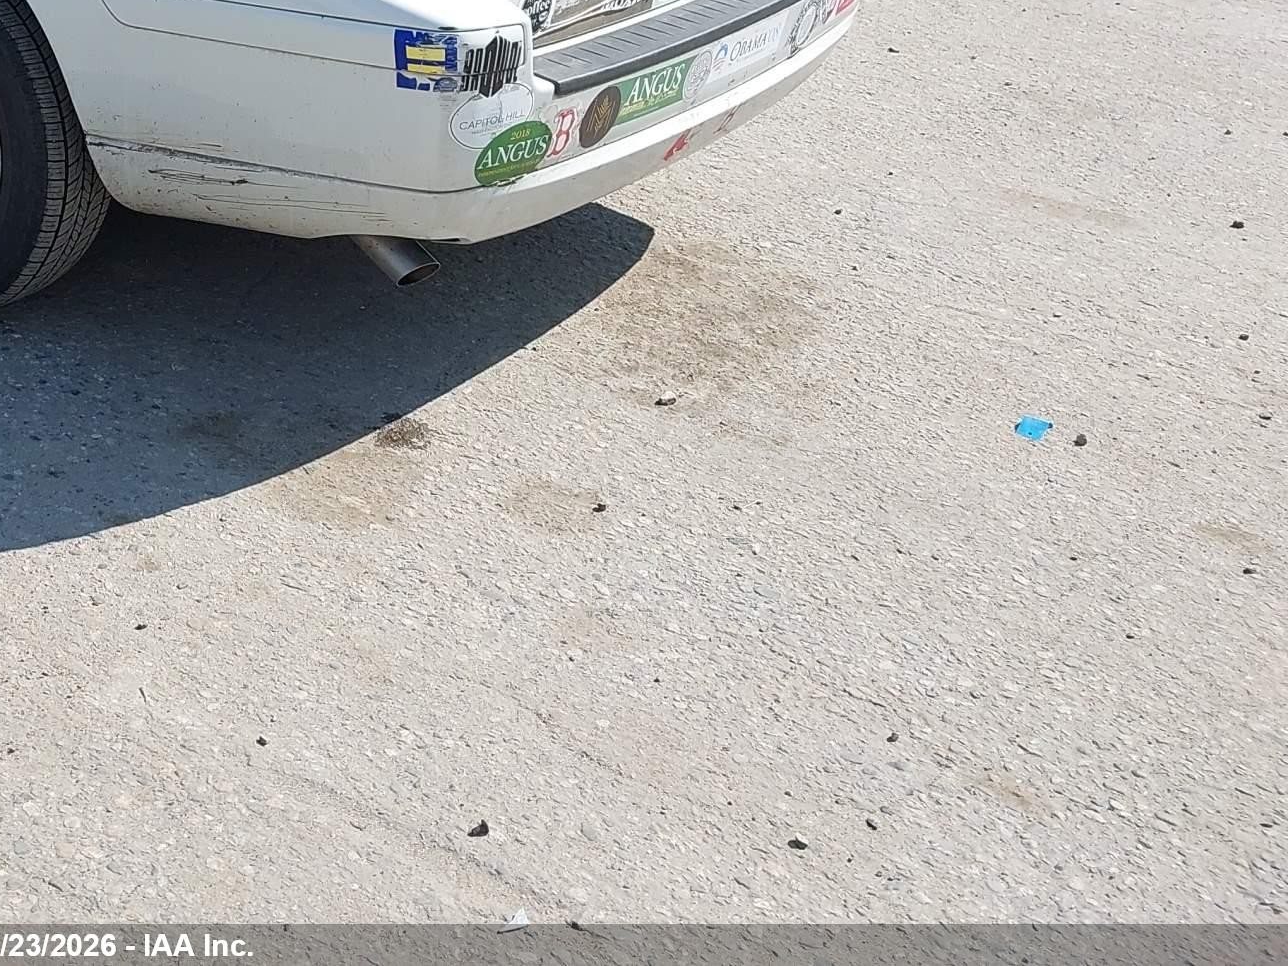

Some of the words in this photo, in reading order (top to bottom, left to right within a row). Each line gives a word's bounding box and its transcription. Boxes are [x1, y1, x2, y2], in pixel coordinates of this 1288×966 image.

[526, 0, 551, 18] offee
[730, 33, 769, 62] OBAMA
[624, 63, 686, 106] ANGUS
[459, 114, 505, 131] CAPITOL
[505, 109, 526, 121] HILL
[510, 128, 530, 140] 2018
[476, 135, 550, 171] ANGUS
